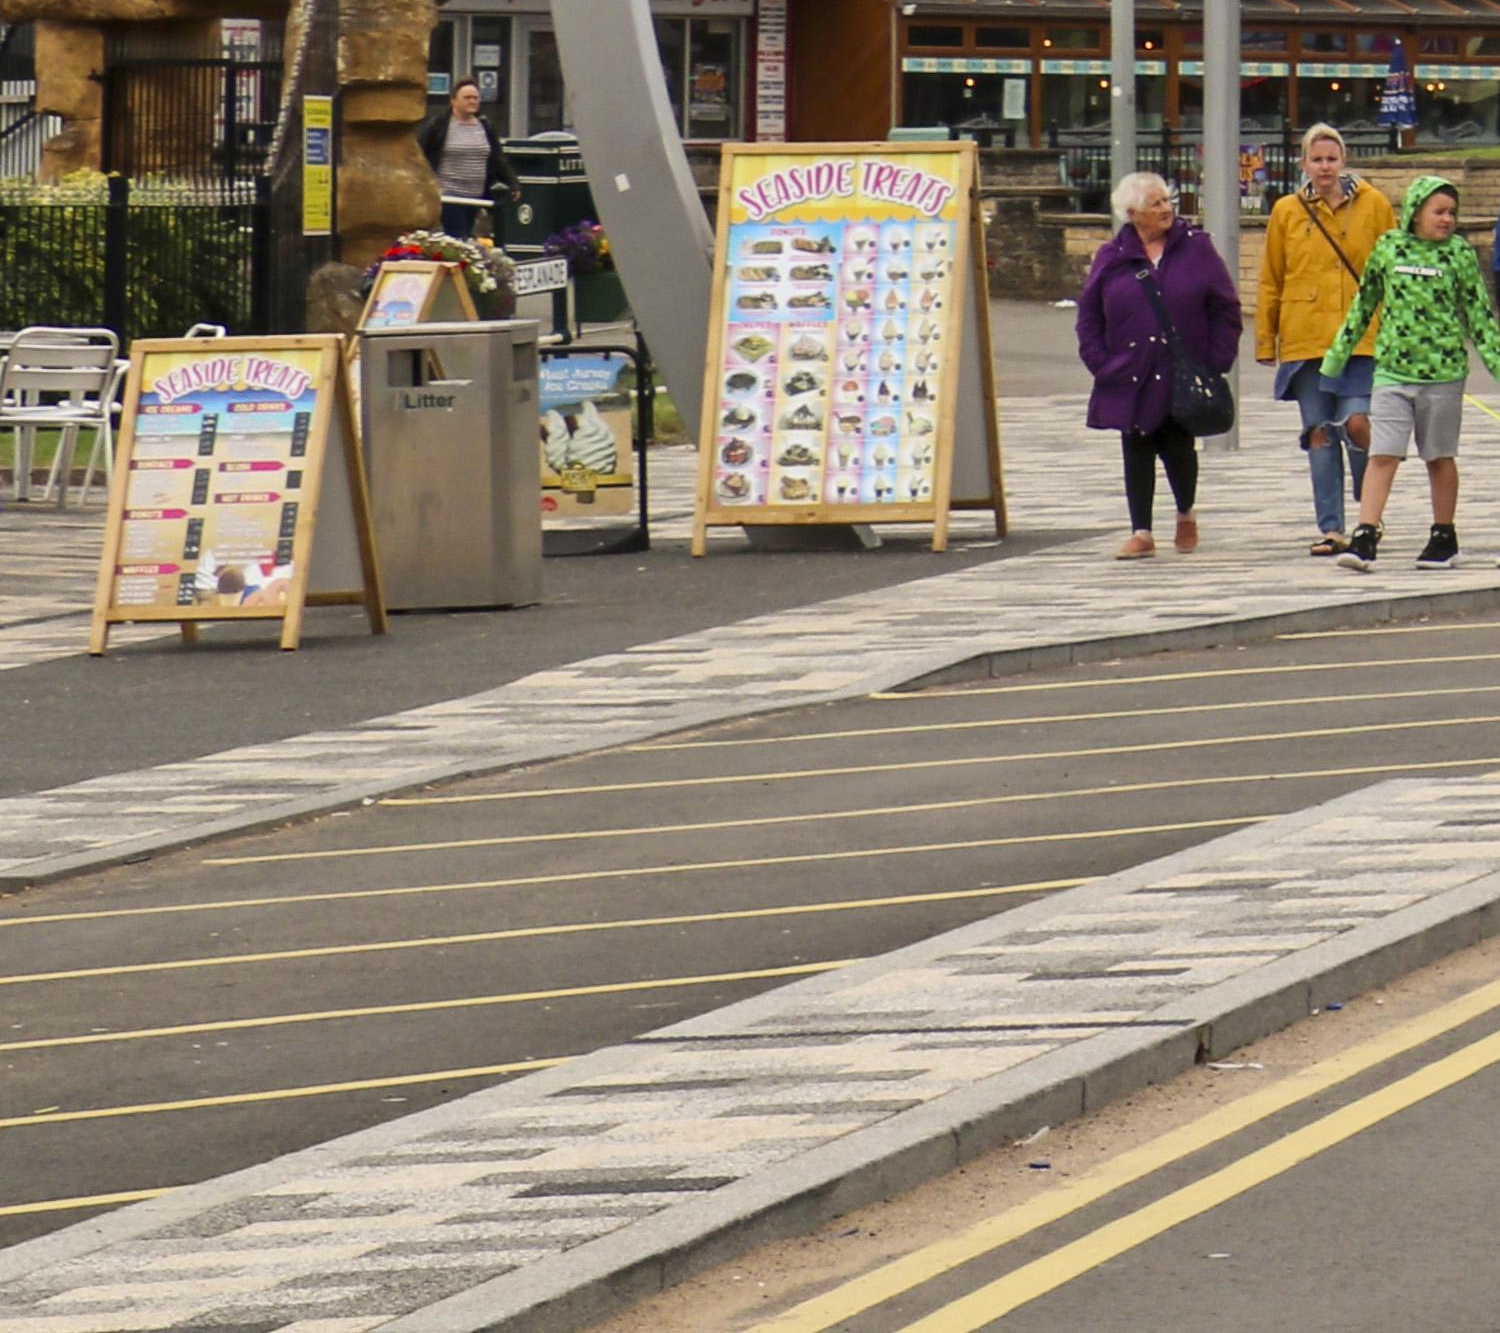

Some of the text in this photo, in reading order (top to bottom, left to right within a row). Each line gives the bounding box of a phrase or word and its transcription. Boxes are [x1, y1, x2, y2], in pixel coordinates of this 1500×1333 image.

[559, 158, 585, 171] LITT
[738, 161, 951, 218] SEASIDE TREATS
[154, 357, 310, 402] SEASIDE TREATS
[404, 393, 456, 410] Litter
